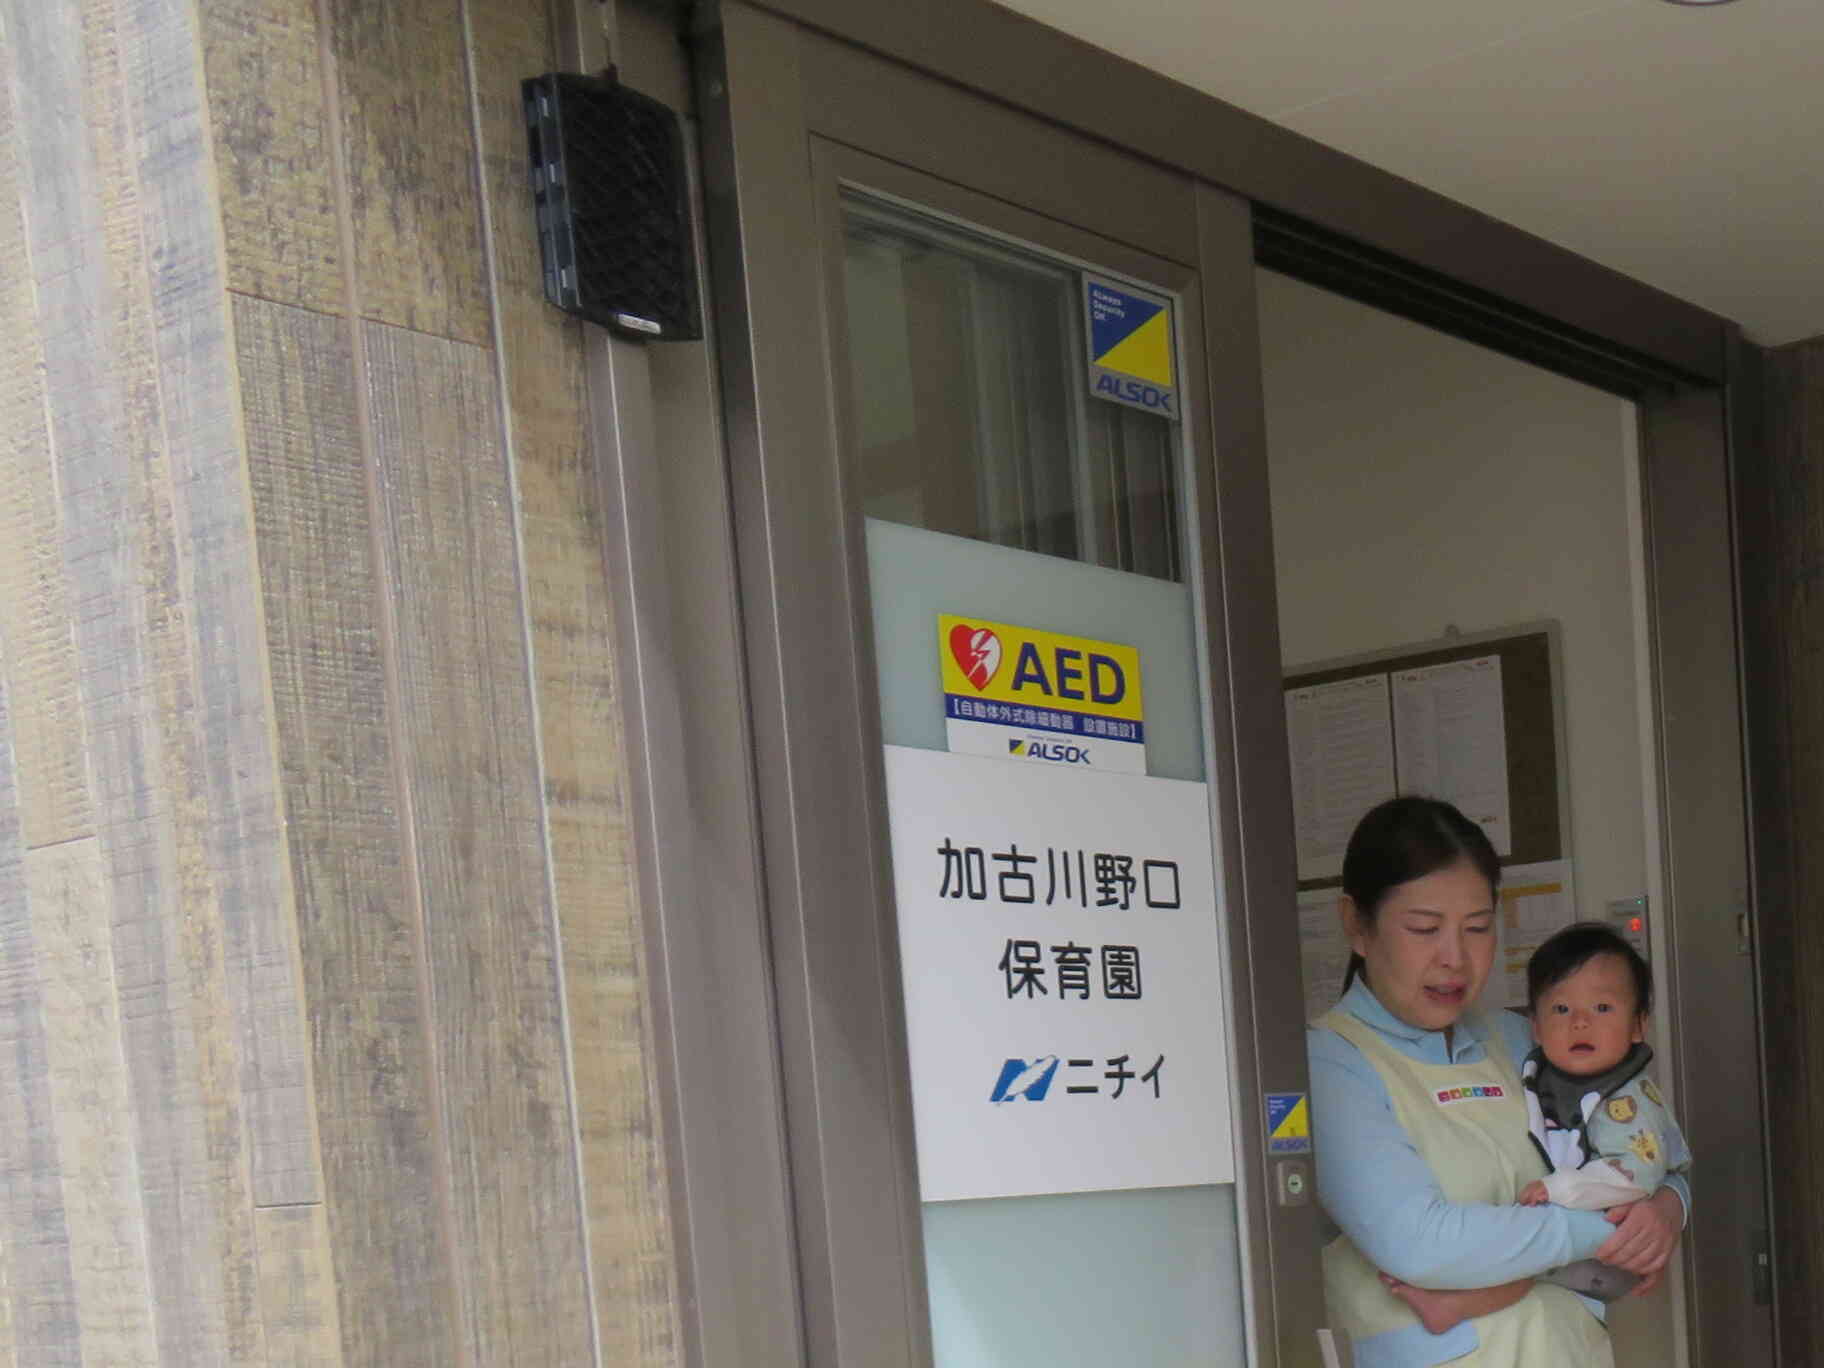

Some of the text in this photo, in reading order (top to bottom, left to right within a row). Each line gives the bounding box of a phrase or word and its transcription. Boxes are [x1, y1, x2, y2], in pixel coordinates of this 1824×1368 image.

[1096, 374, 1173, 413] ALSOK
[1011, 641, 1127, 705] AED
[1027, 741, 1091, 765] ALSOK
[937, 837, 1182, 911] 加古川野口
[998, 938, 1143, 1000] 保育園
[1065, 1054, 1166, 1100] ニチイ
